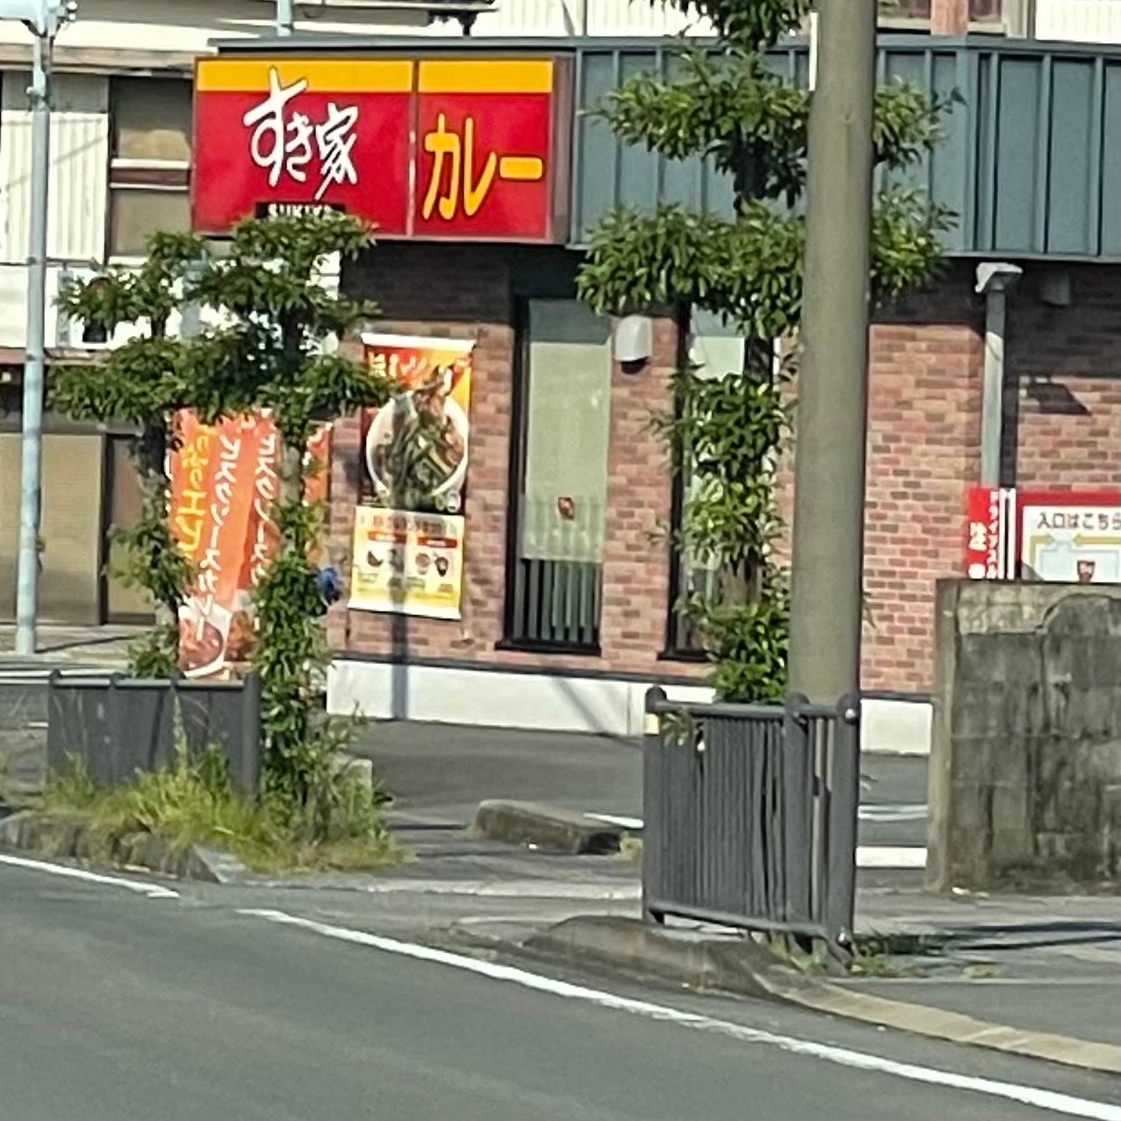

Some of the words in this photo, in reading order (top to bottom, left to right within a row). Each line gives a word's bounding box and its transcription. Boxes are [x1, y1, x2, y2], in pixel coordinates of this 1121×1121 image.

[242, 65, 359, 201] すき家
[423, 113, 544, 221] カレー
[1037, 511, 1121, 531] 入口はこちら
